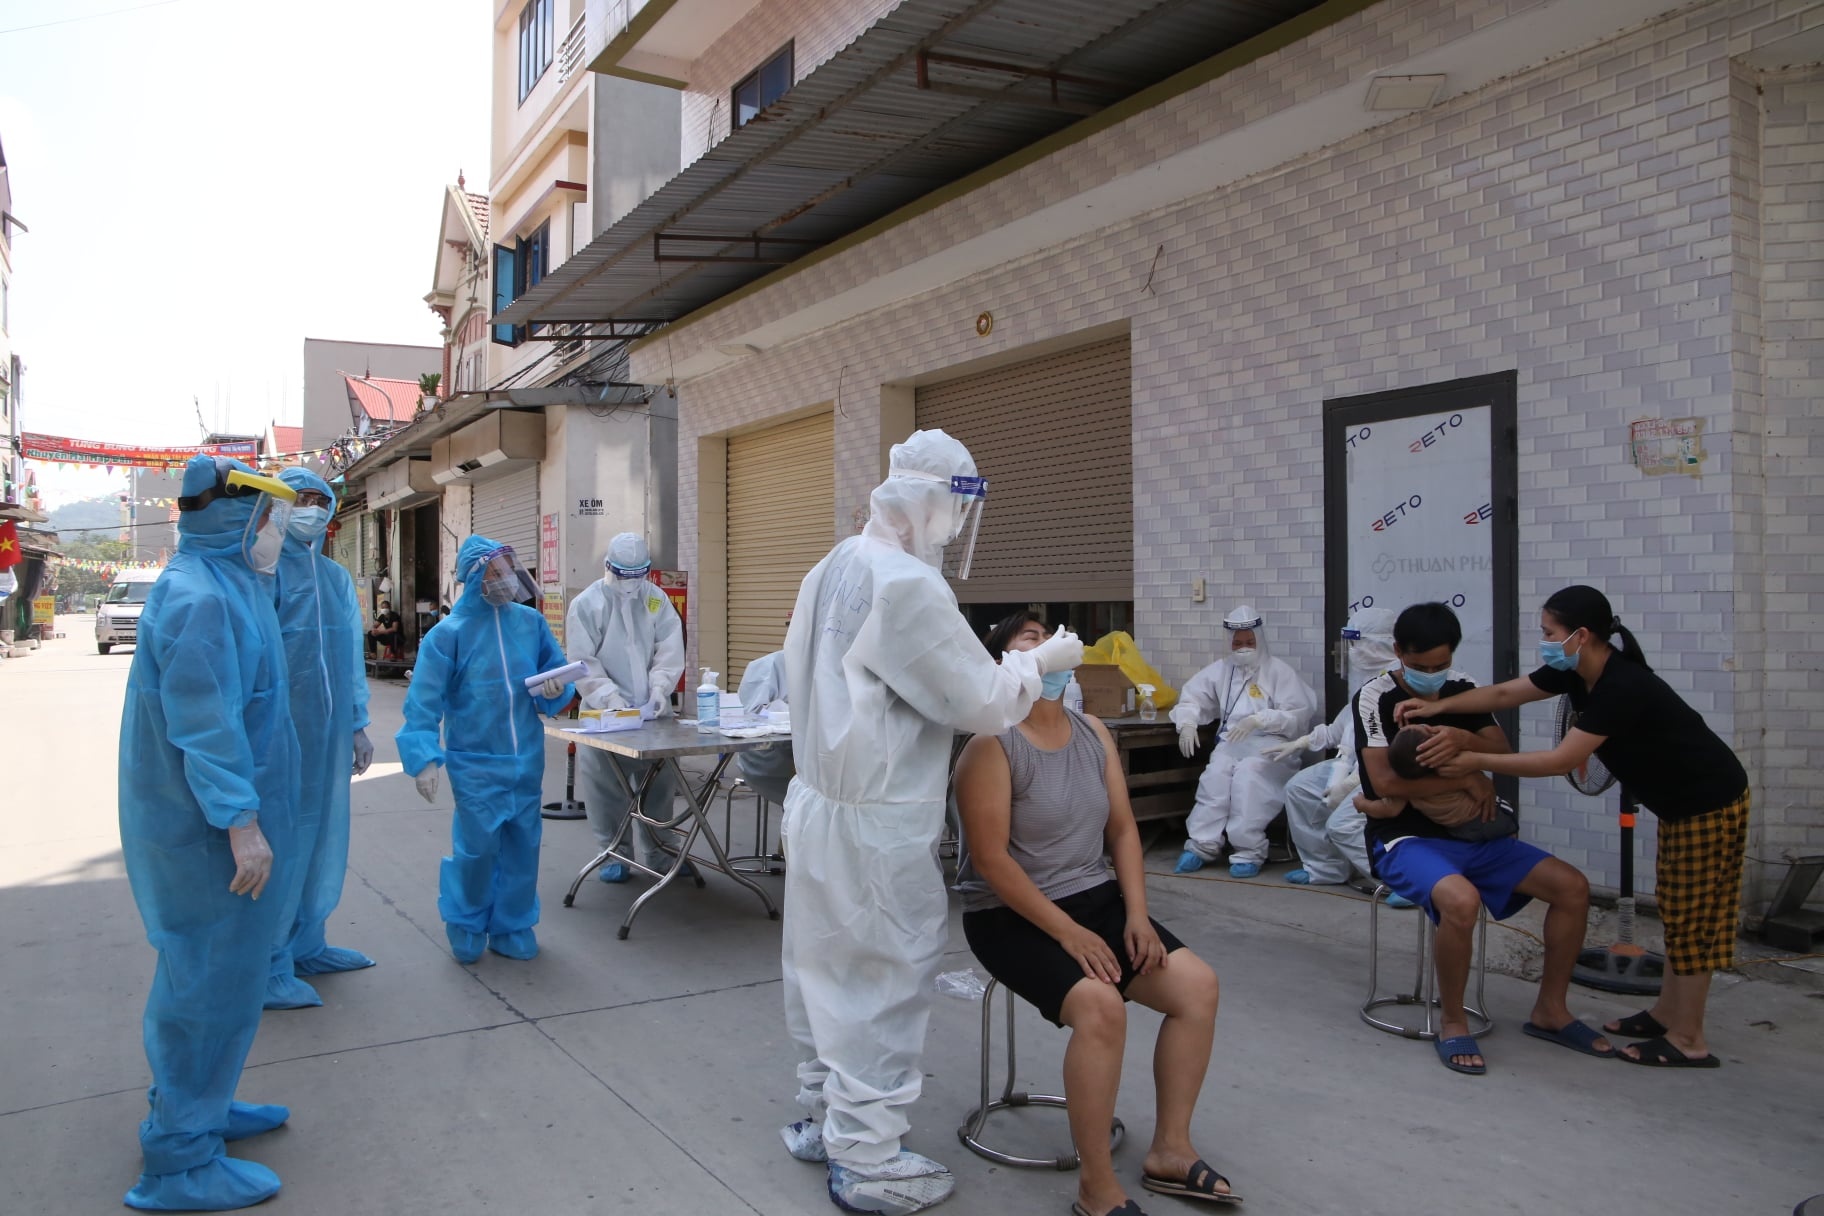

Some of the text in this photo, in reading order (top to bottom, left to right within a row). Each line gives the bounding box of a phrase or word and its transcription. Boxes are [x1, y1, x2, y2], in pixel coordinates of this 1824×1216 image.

[1346, 426, 1371, 448] TO
[579, 499, 589, 508] XE
[1463, 502, 1492, 525] RE
[1348, 595, 1374, 613] TO
